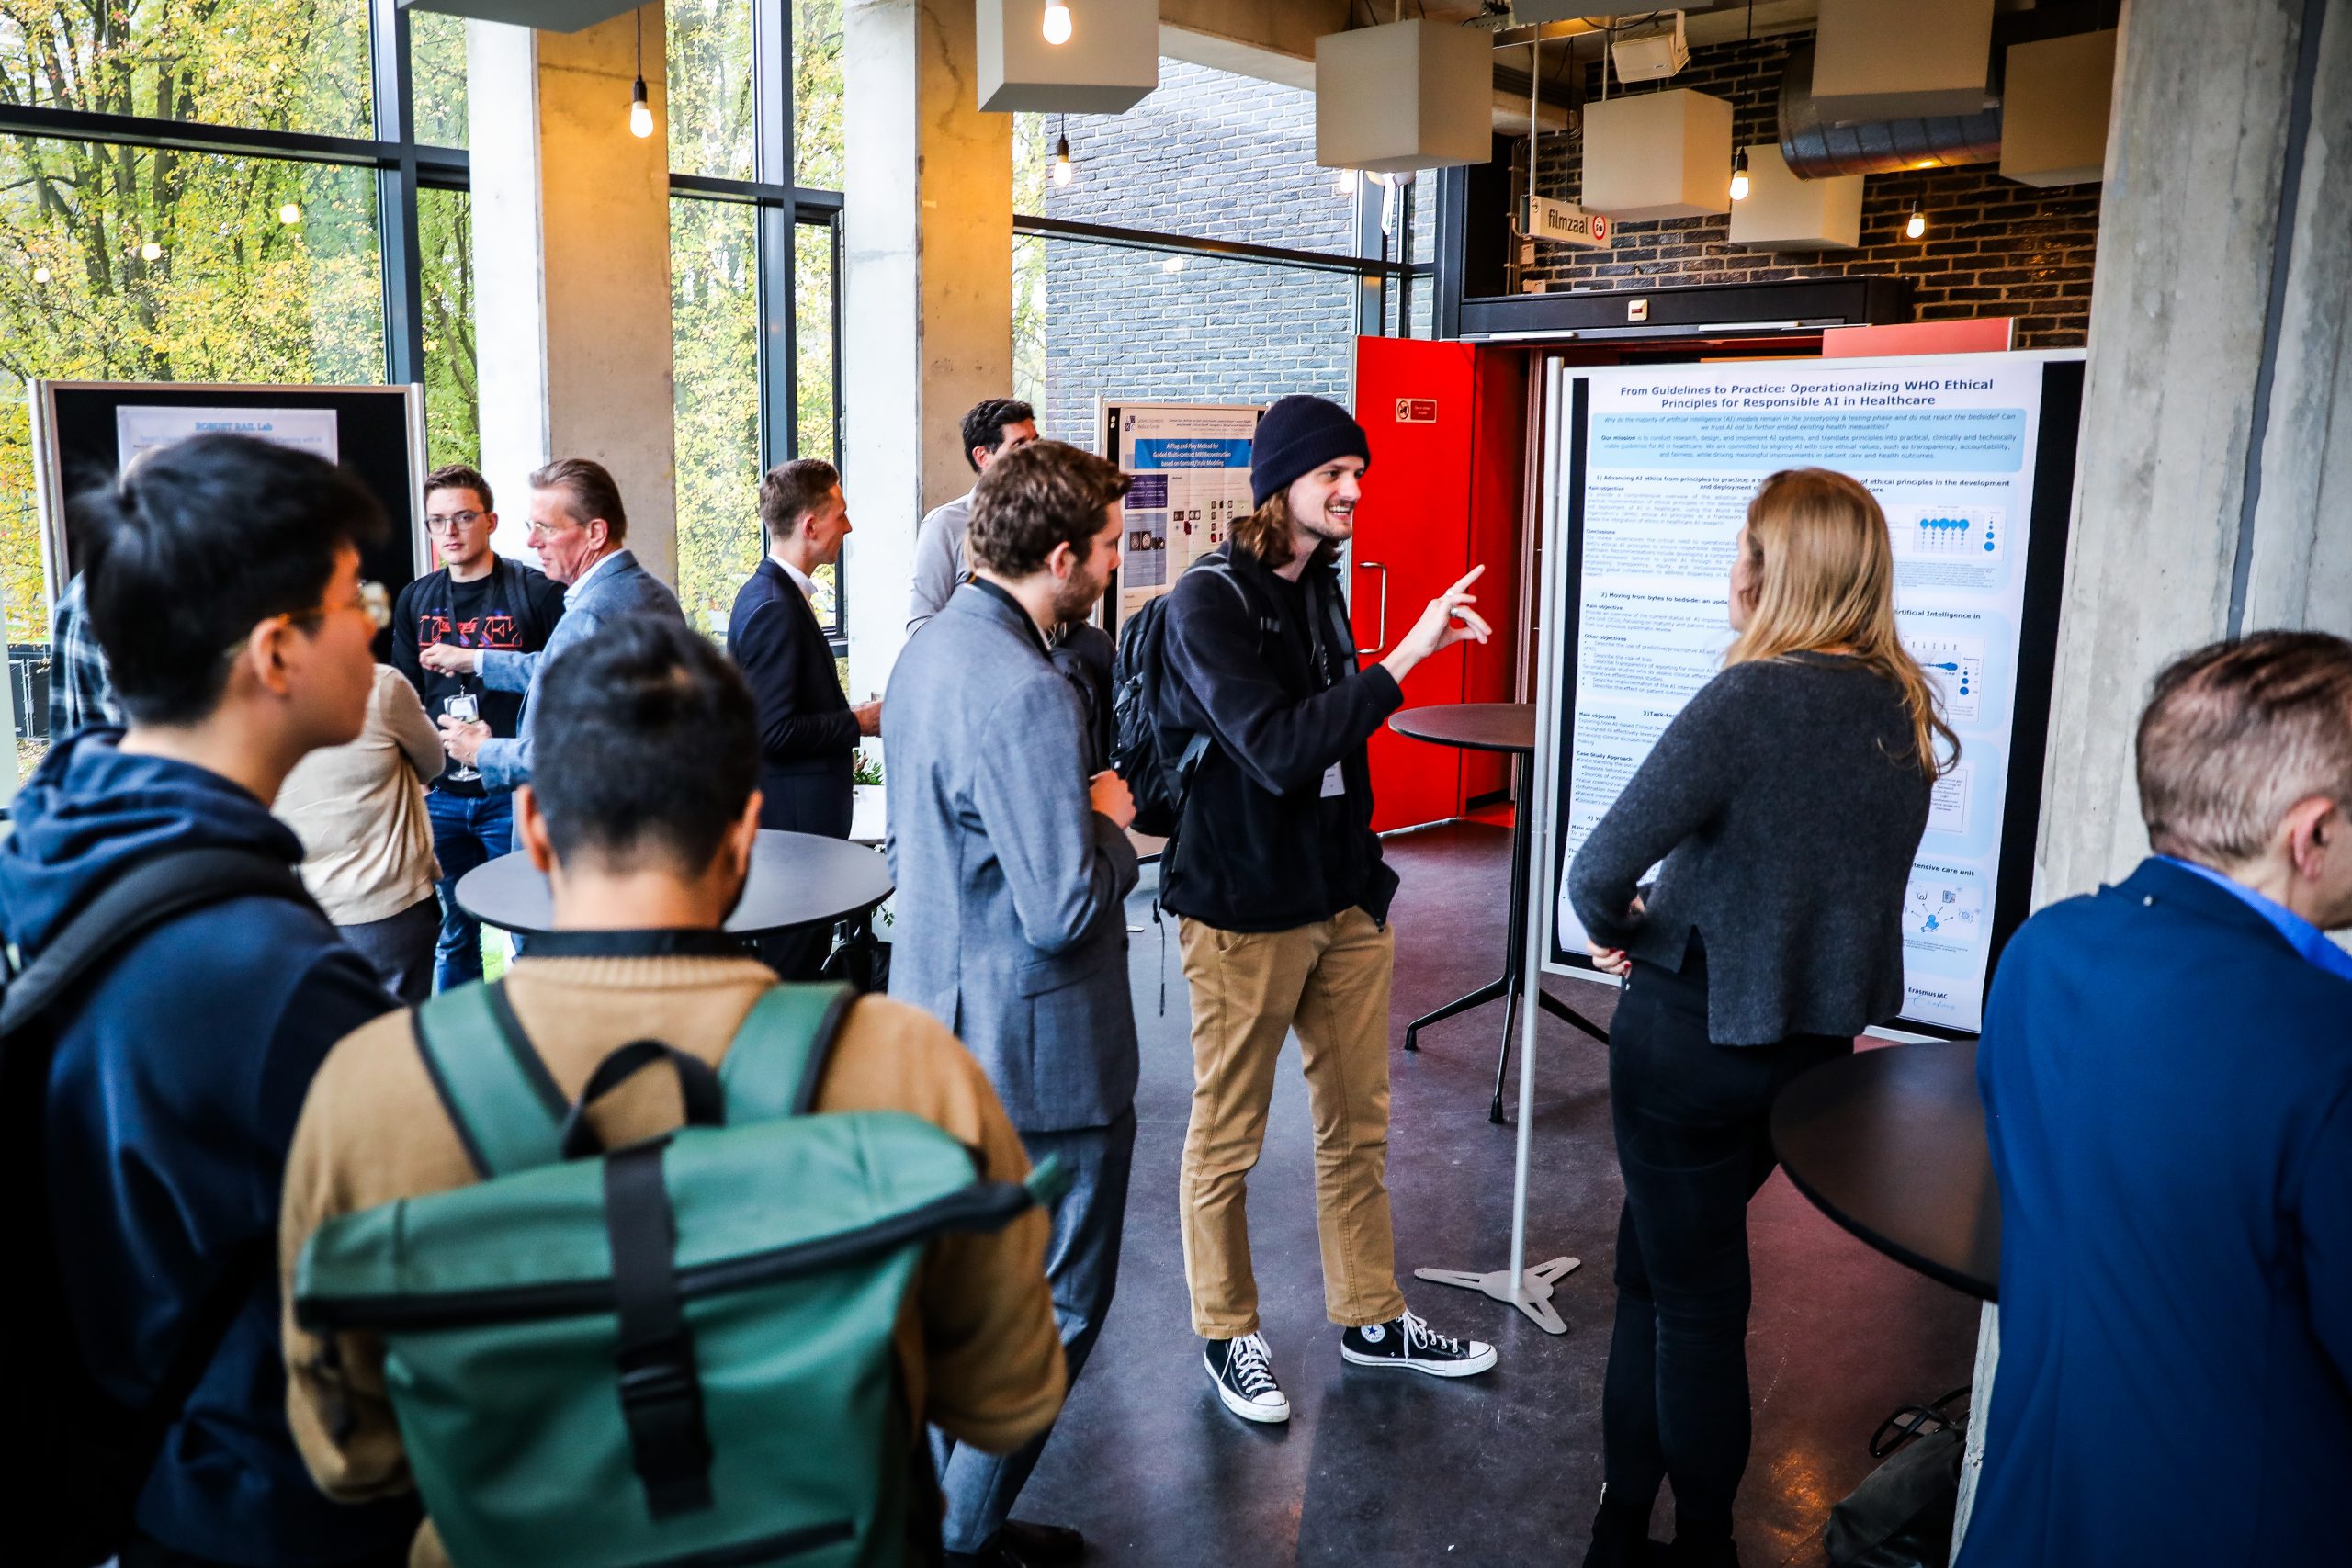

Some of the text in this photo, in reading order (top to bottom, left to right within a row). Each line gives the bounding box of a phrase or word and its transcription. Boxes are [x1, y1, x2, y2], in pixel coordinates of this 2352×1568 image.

[1548, 209, 1589, 235] filmzaal
[1621, 378, 1994, 396] From Guidelines to Practice: Operationalizing WHO Ethical
[1662, 395, 1936, 410] Principles for Responsible AI in Healthcare
[258, 423, 273, 432] Lab
[1927, 611, 1972, 619] Intelligence
[1913, 863, 1940, 872] tensive
